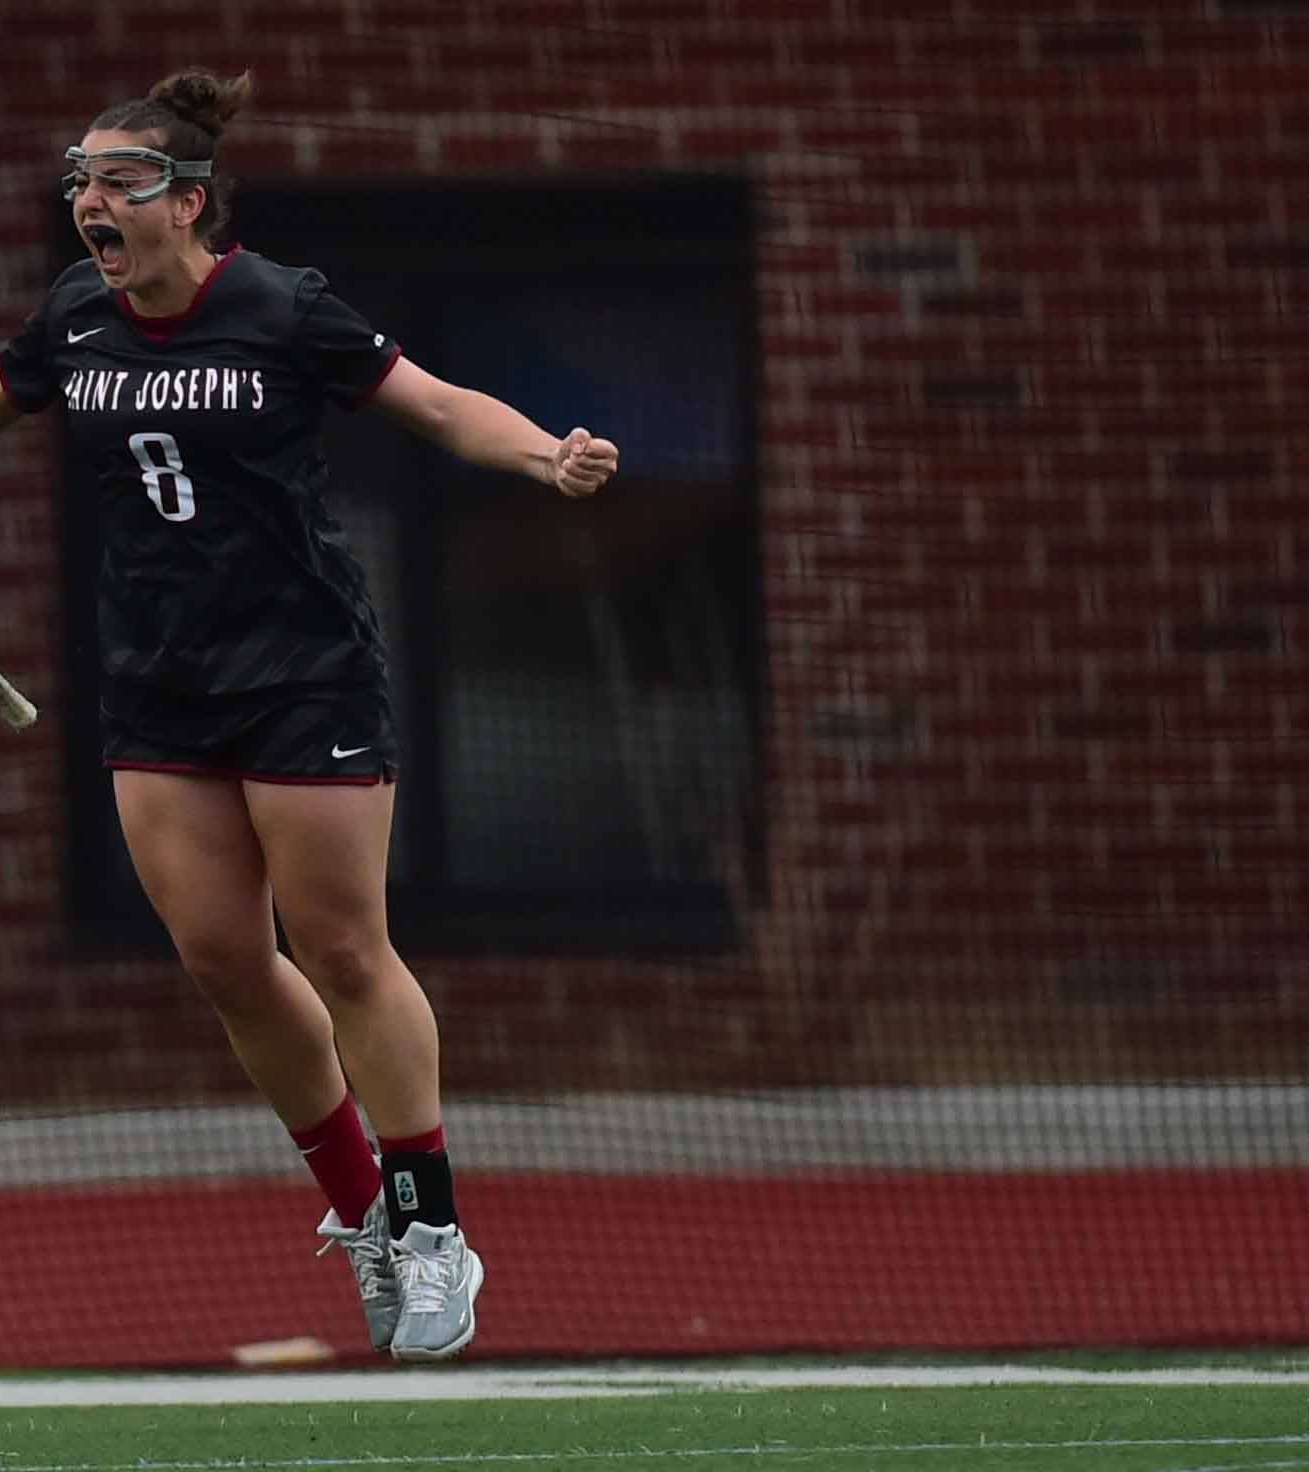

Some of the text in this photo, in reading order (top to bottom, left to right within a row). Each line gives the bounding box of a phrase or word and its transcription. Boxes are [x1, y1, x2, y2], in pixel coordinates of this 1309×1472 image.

[65, 367, 264, 411] AINT JOSEPH'S
[129, 432, 196, 522] 8
